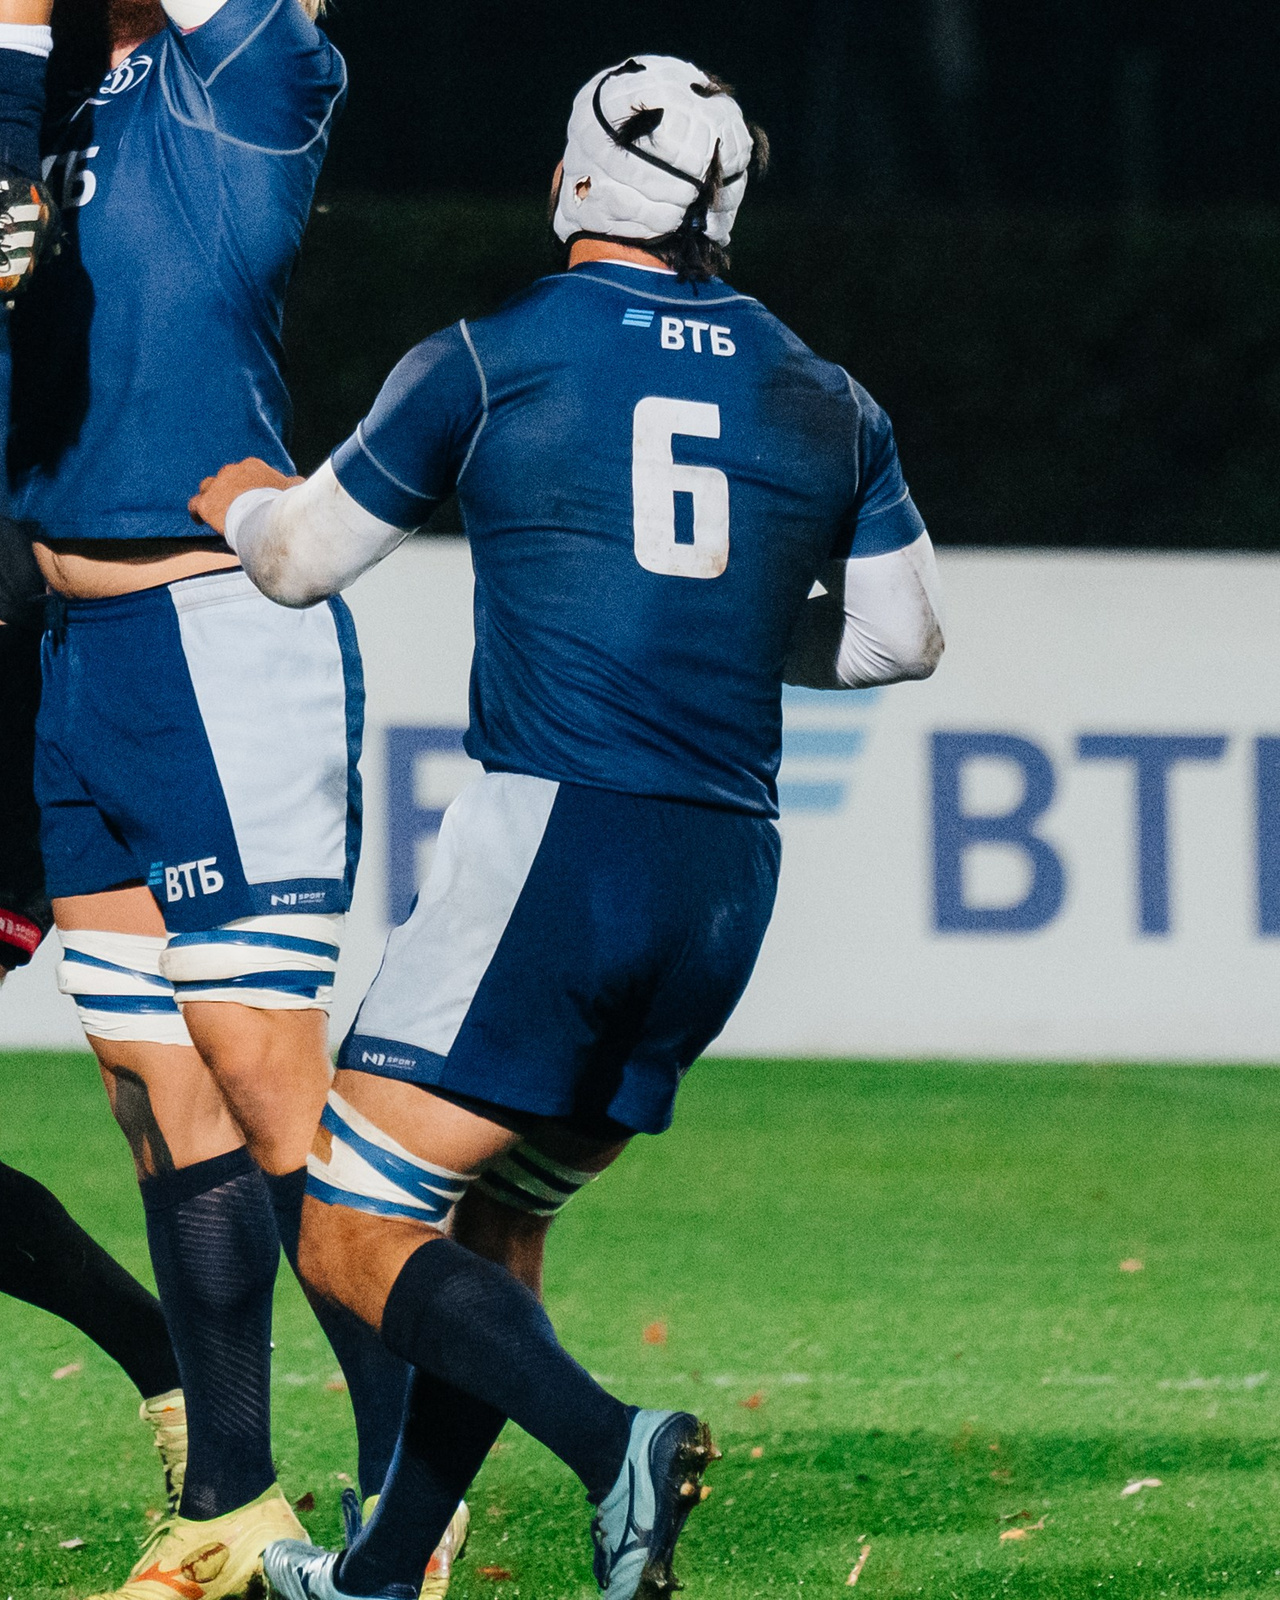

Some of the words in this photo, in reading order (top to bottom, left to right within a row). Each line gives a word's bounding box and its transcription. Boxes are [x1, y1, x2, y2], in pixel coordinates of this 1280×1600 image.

[660, 316, 736, 357] ВТБ
[632, 396, 730, 579] 6
[165, 856, 224, 902] ВТБ
[928, 728, 1280, 940] ВТ
